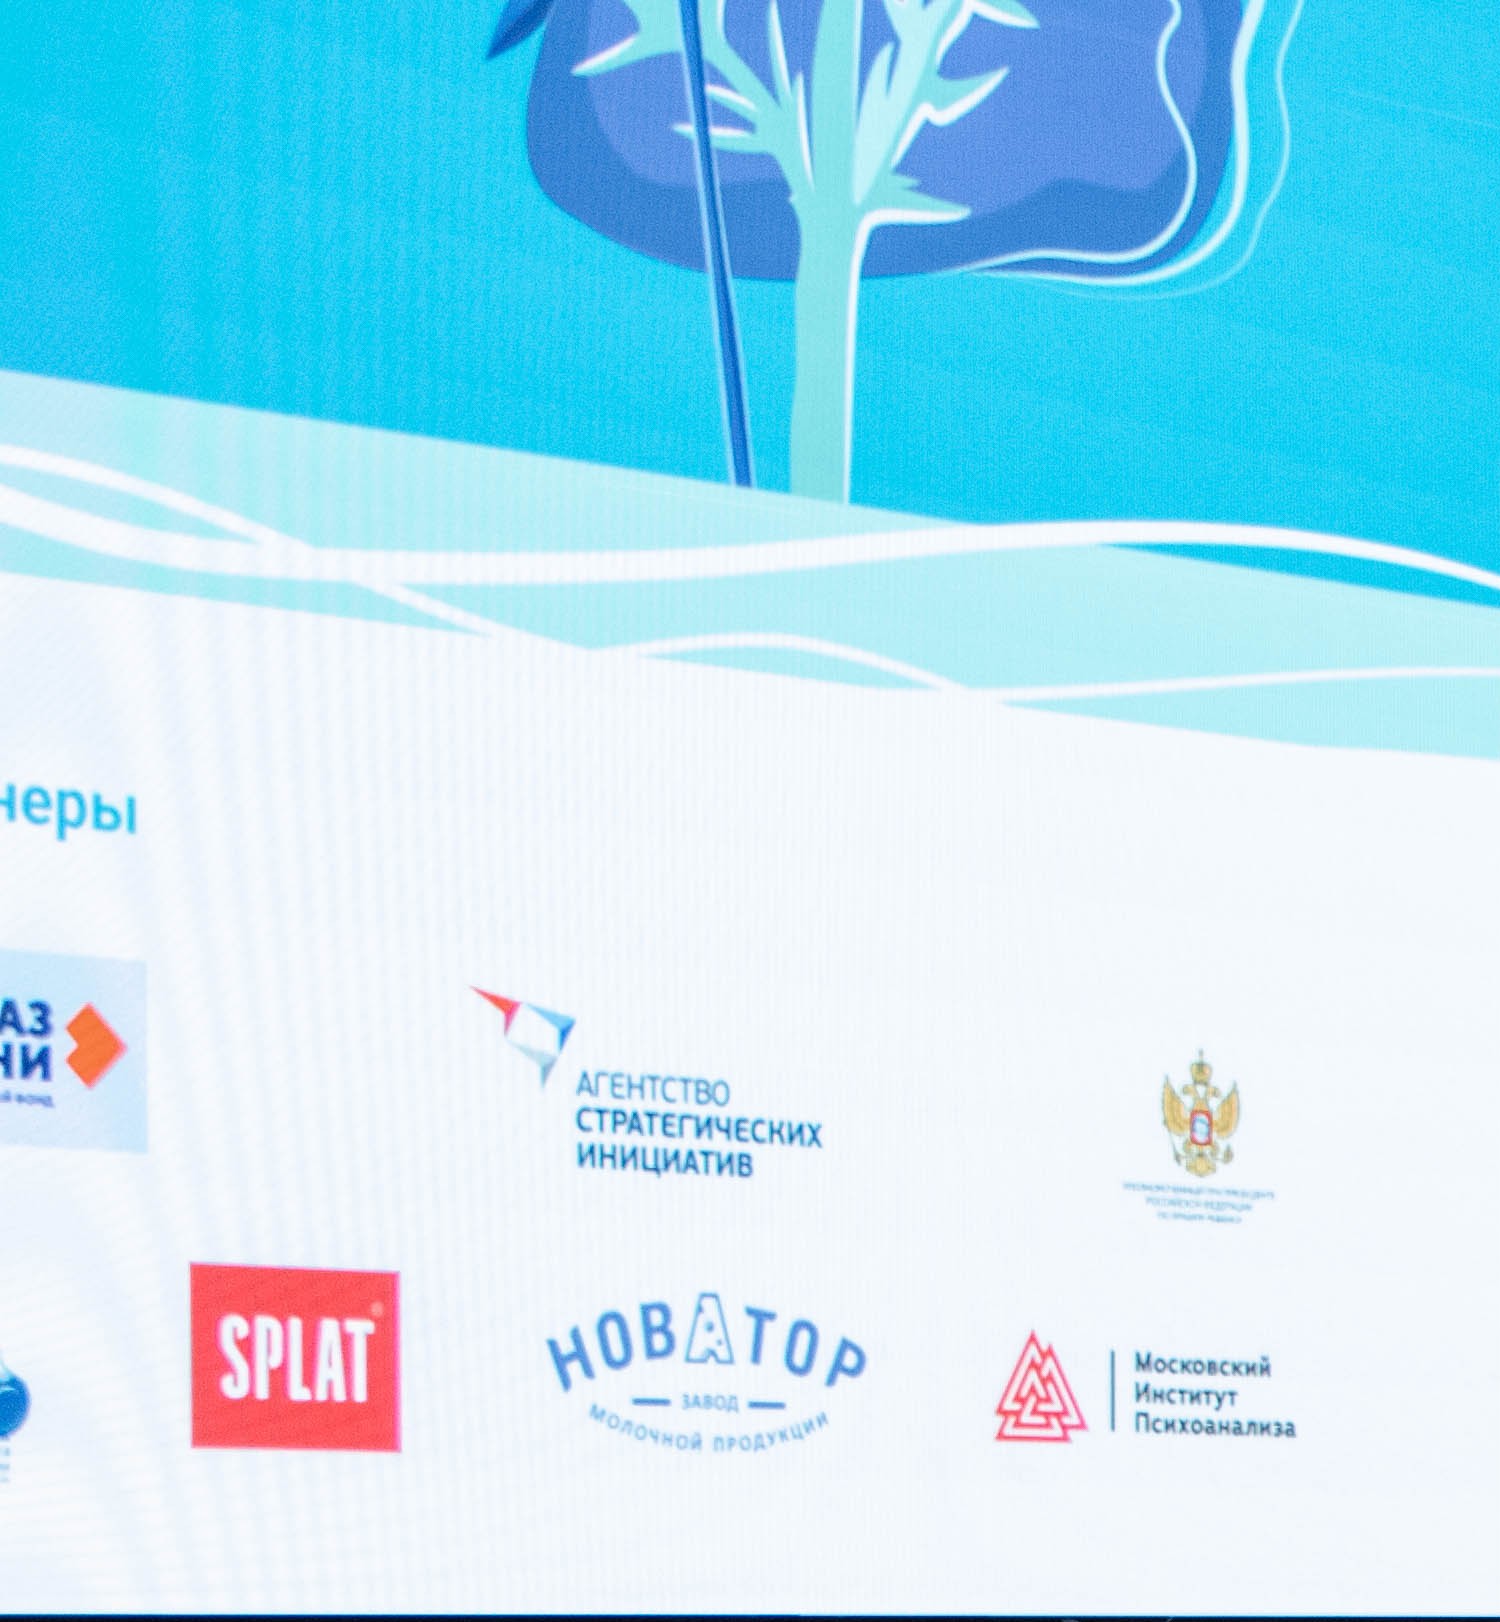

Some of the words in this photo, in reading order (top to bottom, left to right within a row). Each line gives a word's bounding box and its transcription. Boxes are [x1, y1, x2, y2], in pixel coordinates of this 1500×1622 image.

[576, 1070, 730, 1107] АГЕНТСТВО
[576, 1106, 822, 1148] СТРАТЕГИЧЕСКИХ
[577, 1143, 753, 1177] ИНИЦИАТИВ
[218, 1314, 375, 1405] SPLAT
[547, 1292, 868, 1393] НОВАТОР
[1135, 1352, 1271, 1377] Московский
[681, 1395, 740, 1413] ЗАВОД
[1135, 1382, 1237, 1411] Институт
[589, 1404, 702, 1451] МОЛОЧНОЙ
[713, 1412, 829, 1453] ПРОДУКЦИИ
[1135, 1412, 1296, 1438] Психоанализа
